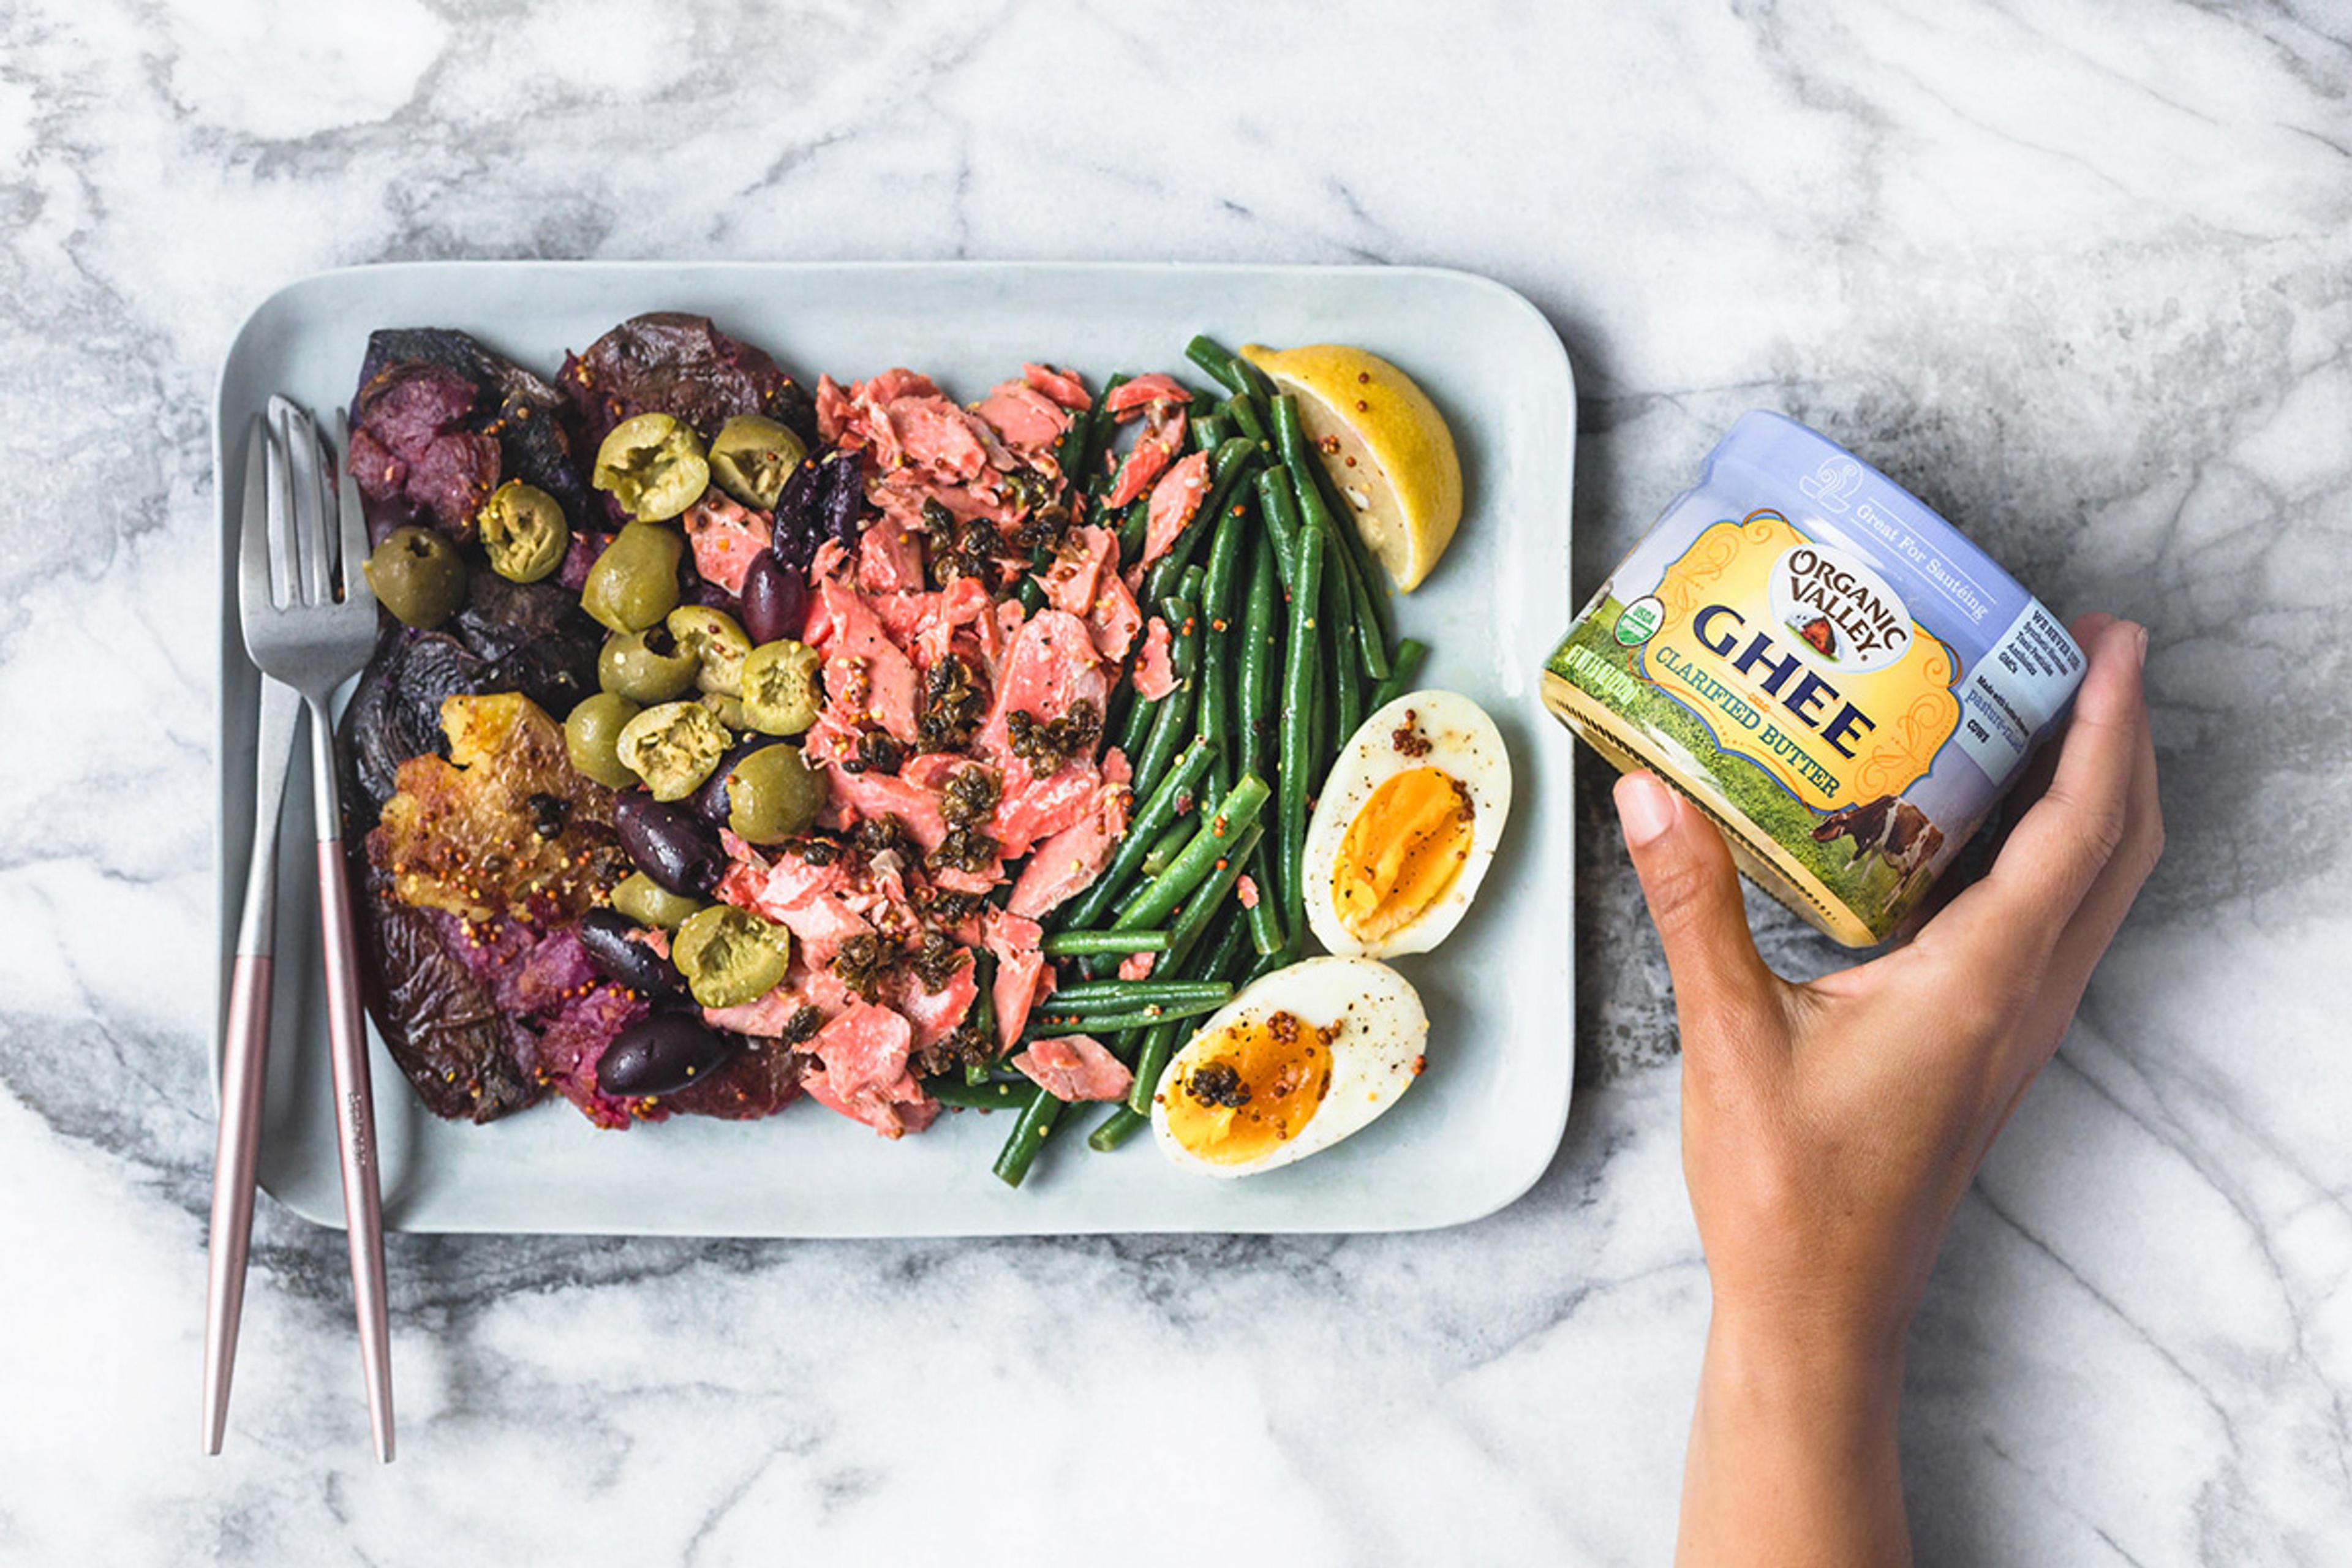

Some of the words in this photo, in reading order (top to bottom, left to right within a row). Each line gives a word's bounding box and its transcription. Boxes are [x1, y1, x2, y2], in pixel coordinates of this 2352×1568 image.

[1789, 549, 1907, 650] ORGANIC
[1856, 504, 1898, 541] Great
[1899, 537, 1928, 562] For
[1926, 558, 1989, 620] Sautéing
[1632, 605, 1656, 625] USDA
[1790, 576, 1882, 655] VALLEY
[2032, 609, 2048, 630] WE
[2045, 624, 2073, 660] NEVER
[1656, 646, 1761, 731] CLARIFIED
[1758, 722, 1841, 798] BUTTER
[1693, 605, 1877, 760] GHEE
